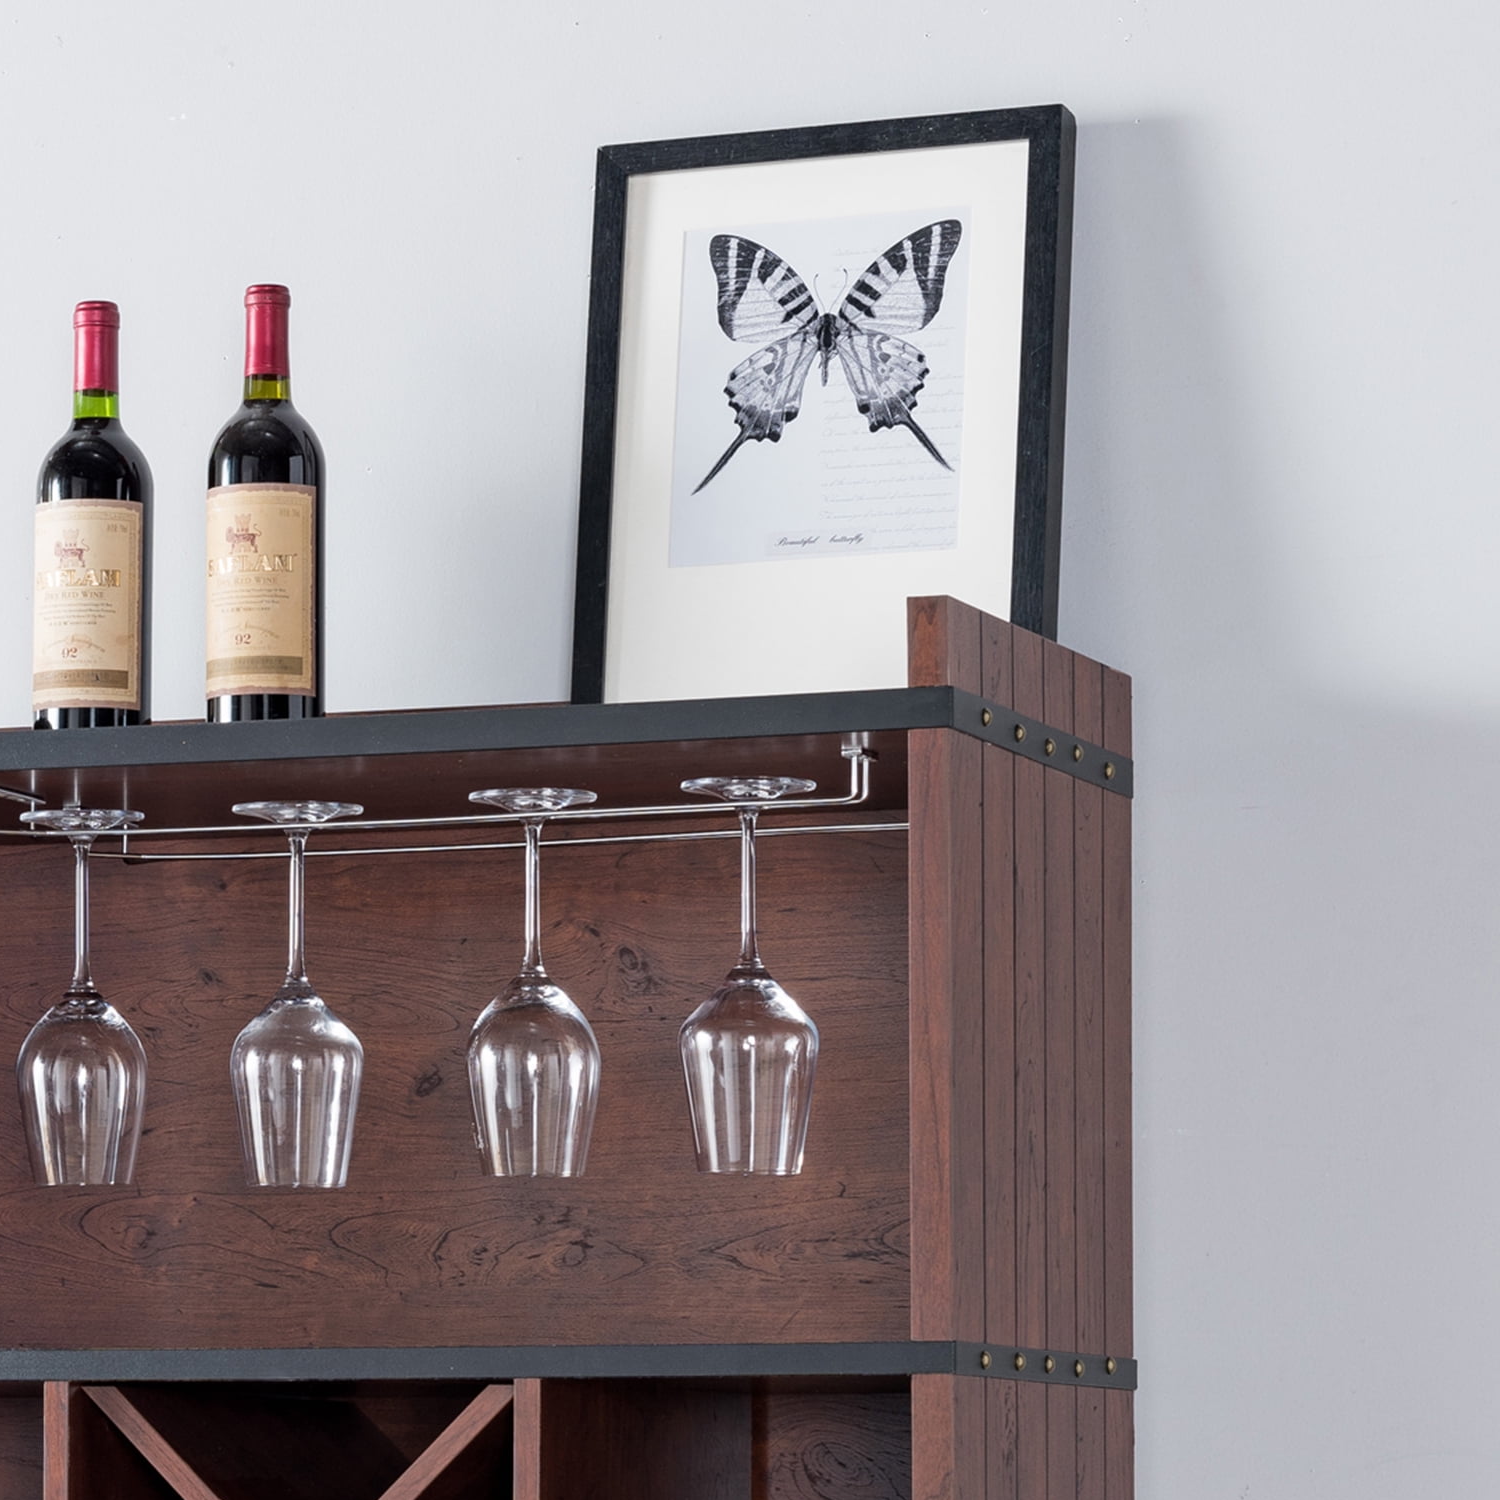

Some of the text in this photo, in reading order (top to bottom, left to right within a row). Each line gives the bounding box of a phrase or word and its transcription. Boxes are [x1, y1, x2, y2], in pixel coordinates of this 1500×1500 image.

[61, 591, 80, 599] RED
[81, 590, 105, 599] WINE
[234, 633, 252, 645] 92
